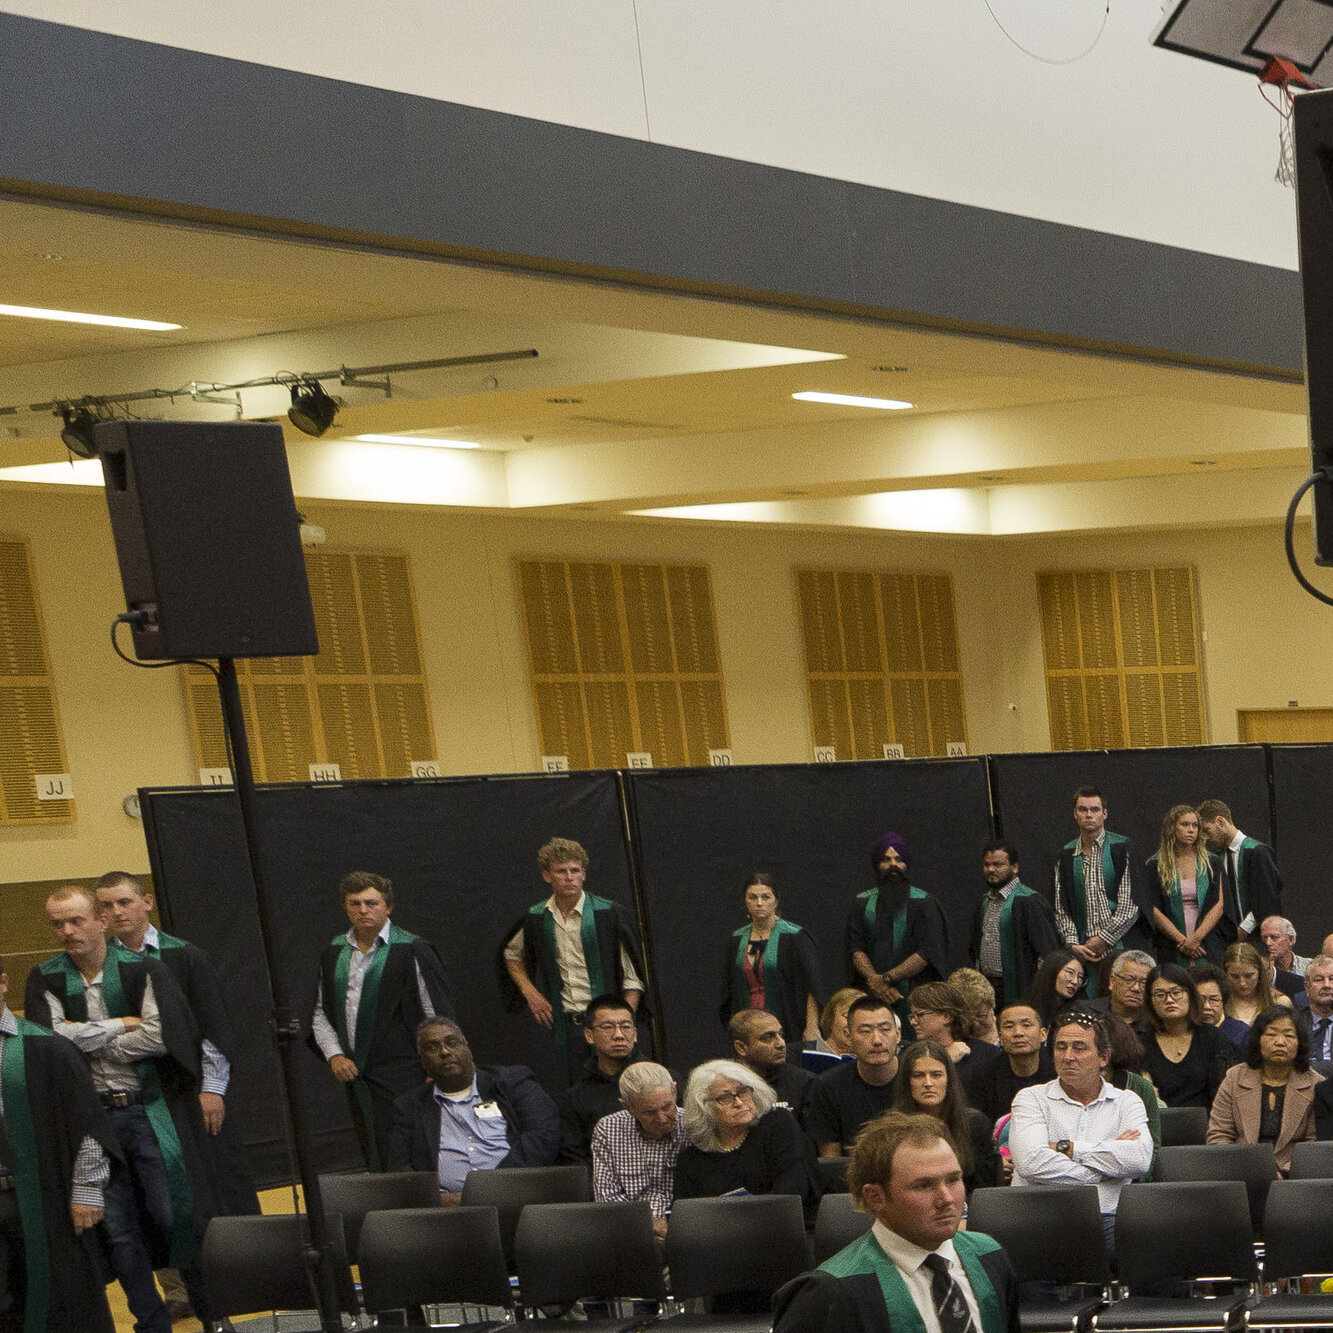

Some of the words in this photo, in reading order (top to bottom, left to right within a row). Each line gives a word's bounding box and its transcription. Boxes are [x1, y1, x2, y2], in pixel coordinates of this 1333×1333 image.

[816, 750, 833, 764] CC
[886, 748, 902, 760] BB
[950, 746, 964, 757] AA
[712, 754, 731, 767] DD
[314, 769, 338, 782] HH
[416, 765, 438, 779] GG
[46, 780, 64, 796] JJ
